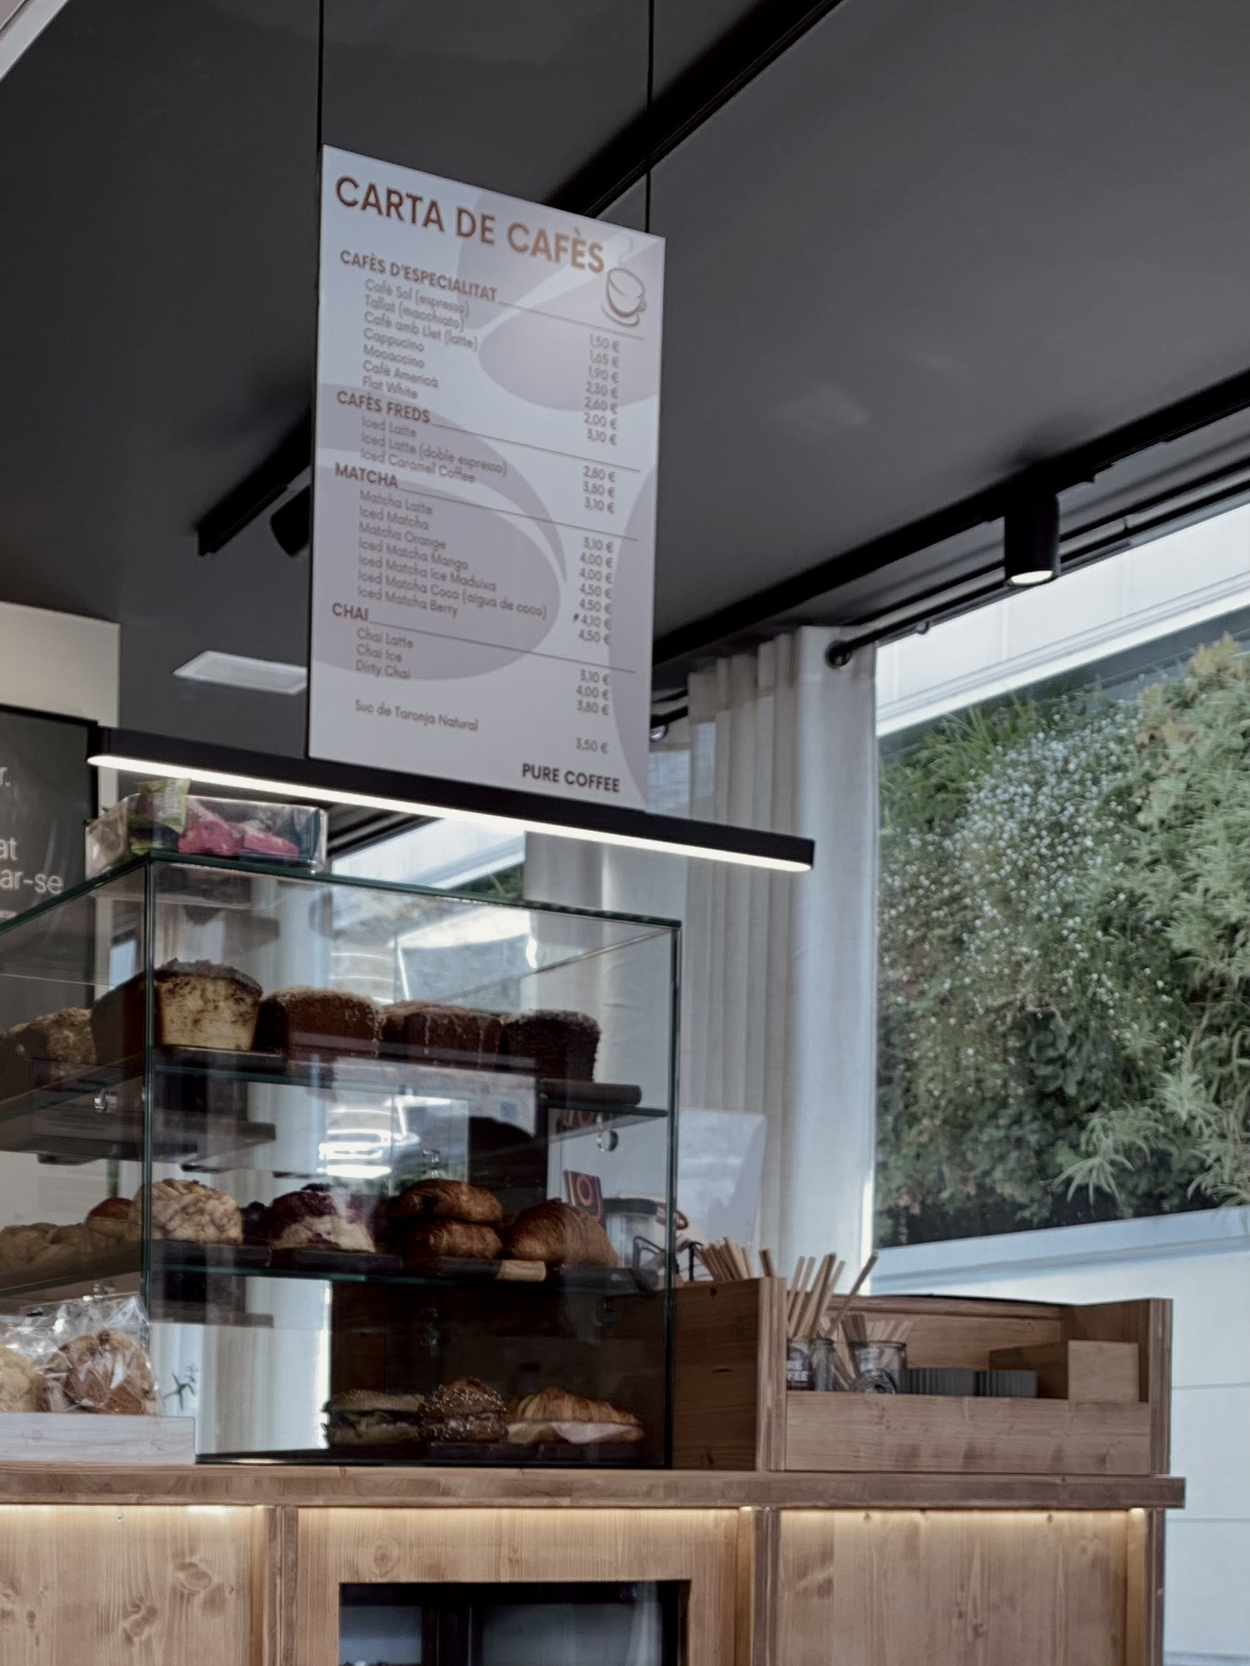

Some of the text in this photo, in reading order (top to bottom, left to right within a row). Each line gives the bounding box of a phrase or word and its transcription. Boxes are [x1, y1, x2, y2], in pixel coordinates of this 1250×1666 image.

[335, 176, 605, 273] CARTA DE CAFÈS
[340, 250, 498, 301] CAFÈS D'ESPECIALITAT
[364, 293, 464, 332] Tallat (macchiato)
[396, 285, 412, 299] Sol
[415, 288, 469, 317] (espresso)
[395, 320, 420, 334] amb
[422, 324, 442, 340] Llet
[445, 328, 478, 352] (latte)
[363, 343, 425, 368] Mocaccino
[363, 375, 418, 399] Flat White
[337, 390, 431, 423] CAFÈS FREDS
[361, 415, 417, 438] Iced Latte
[360, 448, 476, 483] Iced Caramel Coffee
[361, 431, 507, 477] Iced Latte (doble espresso)
[335, 462, 399, 489] MATCHA
[359, 489, 433, 515] Matcha Latte
[359, 504, 429, 531] Iced Matcha
[358, 520, 446, 552] Matcha Orange
[358, 536, 469, 572] Iced Matcha Mango
[358, 552, 383, 569] Iced
[385, 558, 428, 578] Matcha
[430, 567, 447, 582] Ice
[357, 568, 547, 621] Iced Matcha Coco (aigua de coco)
[357, 584, 459, 620] Iced Matcha Berry
[332, 602, 369, 622] CHAI
[355, 643, 403, 663] Chai Ice
[356, 626, 414, 649] Chai Latte
[355, 659, 411, 680] Dirty Chai
[354, 698, 479, 732] Suc de Taronja Natural
[522, 762, 620, 793] PURE COFFEE
